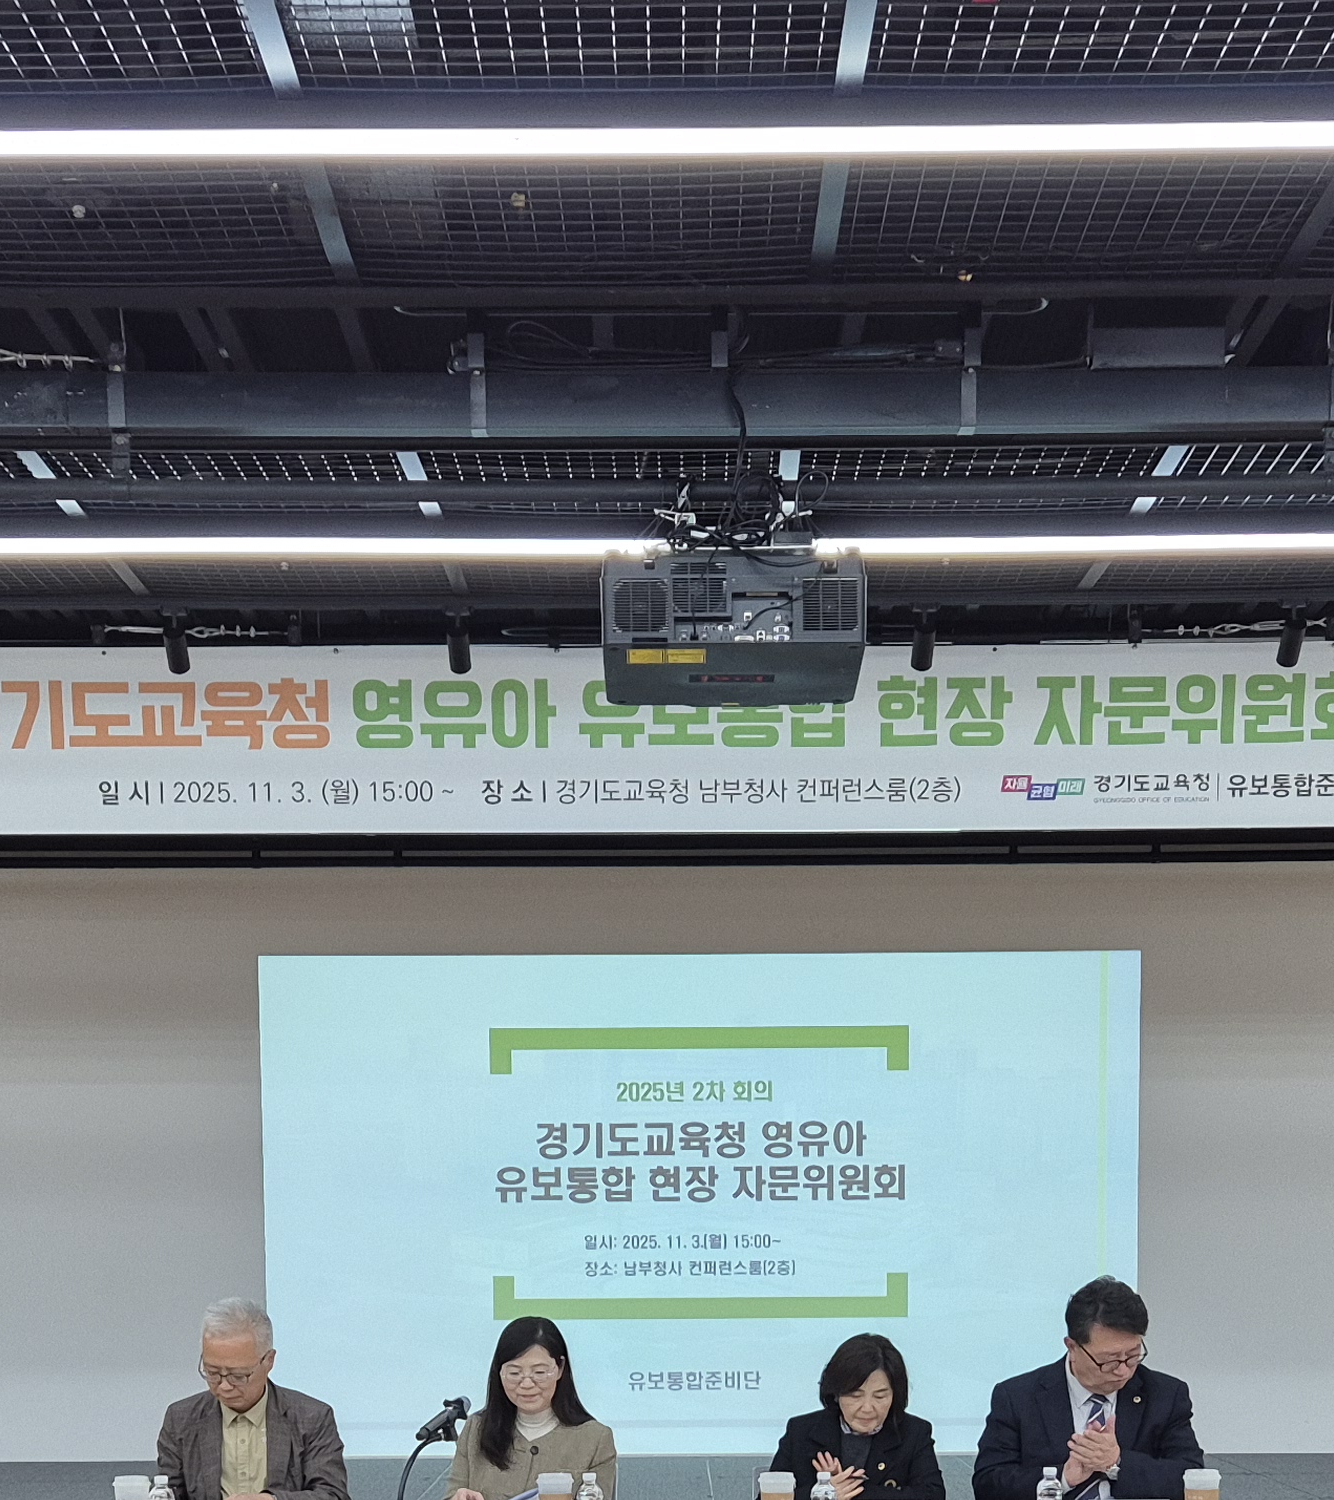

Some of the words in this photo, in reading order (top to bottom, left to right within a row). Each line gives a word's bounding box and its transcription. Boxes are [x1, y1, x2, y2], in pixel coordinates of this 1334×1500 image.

[352, 677, 556, 750] 영유아
[876, 674, 1013, 748] 현장
[248, 781, 282, 803] 11.
[291, 780, 312, 803] 3.
[321, 778, 359, 806] (월)
[369, 780, 434, 803] 15:00
[555, 777, 689, 804] 경기도교육청
[699, 777, 788, 804] 남부청사
[796, 776, 962, 804] 컨퍼런스룸(2층)
[1093, 773, 1210, 793] 경기도교육청
[616, 1081, 684, 1102] 2025년
[692, 1081, 725, 1102] 2차
[733, 1079, 773, 1102] 회의
[535, 1121, 746, 1159] 경기도교육청
[762, 1120, 866, 1158] 영유아
[495, 1165, 635, 1203] 유보통합
[649, 1165, 718, 1202] 현장
[732, 1164, 906, 1201] 자문위원회
[584, 1234, 617, 1251] 일시:
[622, 1234, 661, 1250] 2025.
[667, 1235, 688, 1249] 11.
[584, 1260, 618, 1278] 장소:
[623, 1259, 682, 1278] 남부청사
[689, 1259, 796, 1278] 컨퍼런스룸(2층)
[628, 1371, 761, 1392] 유보통합준비단
